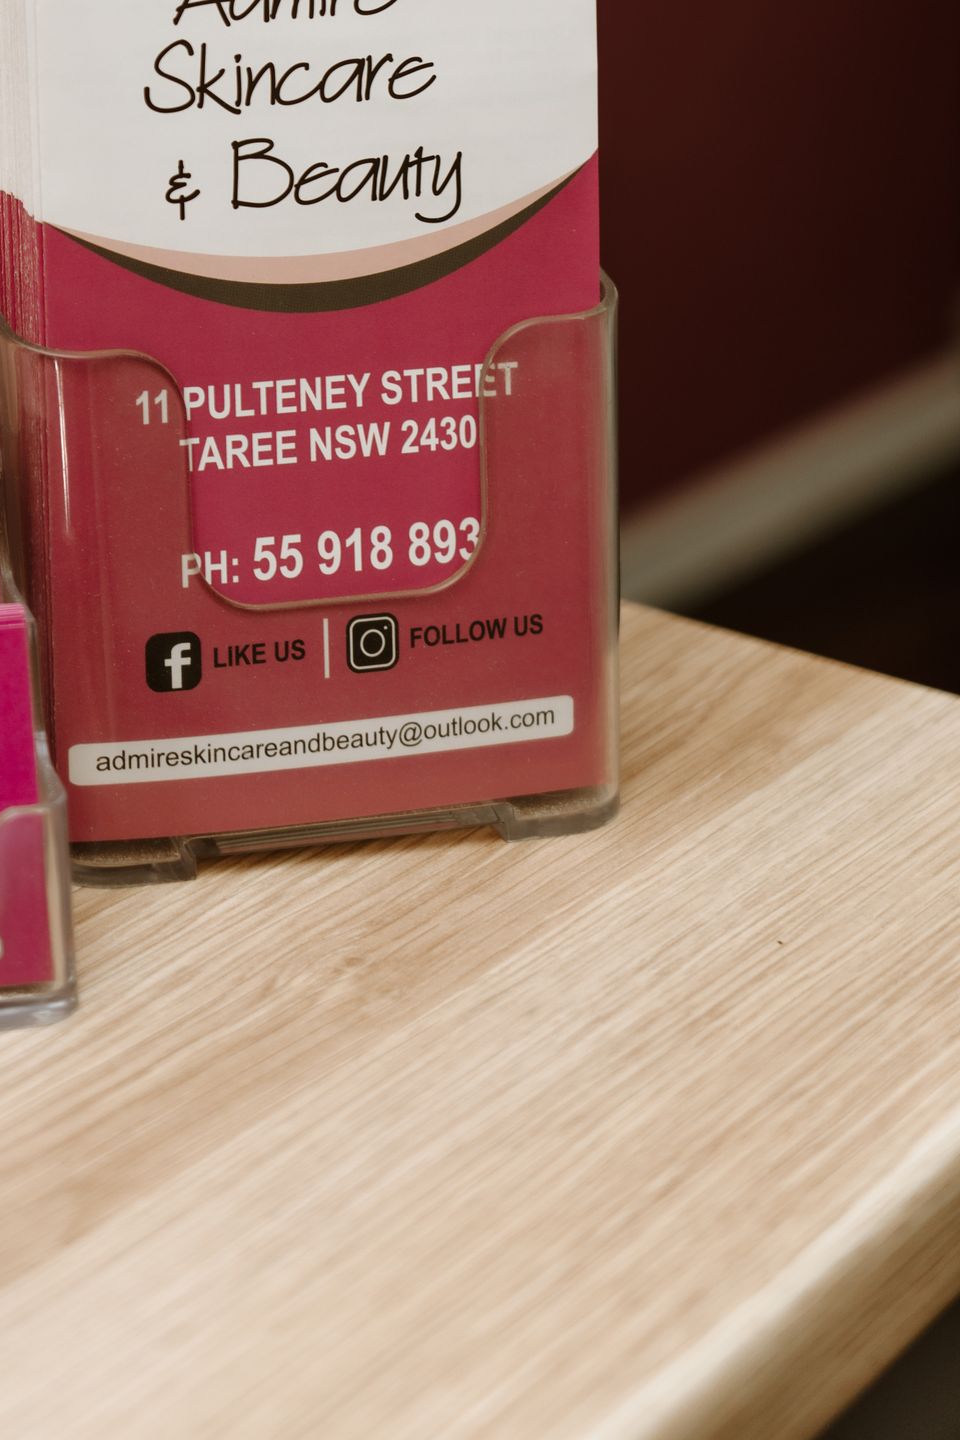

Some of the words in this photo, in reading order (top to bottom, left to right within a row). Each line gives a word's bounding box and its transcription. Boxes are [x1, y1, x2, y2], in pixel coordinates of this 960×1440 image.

[143, 39, 436, 114] Skincare
[165, 160, 200, 220] &
[231, 138, 462, 223] Beauty
[135, 388, 169, 425] 11
[183, 372, 371, 420] PULTENEY
[380, 361, 519, 405] STREET
[179, 429, 298, 472] TAREE
[309, 421, 391, 462] NSW
[401, 414, 477, 454] 2430
[181, 550, 240, 588] PH:
[253, 534, 304, 581] 55
[317, 525, 393, 575] 918
[408, 516, 481, 567] 893
[213, 643, 267, 668] LIKE
[274, 639, 306, 663] US
[409, 617, 511, 649] FOLLOW
[513, 613, 544, 638] US
[95, 705, 555, 773] admireskincareandbeauty@outlook.com
